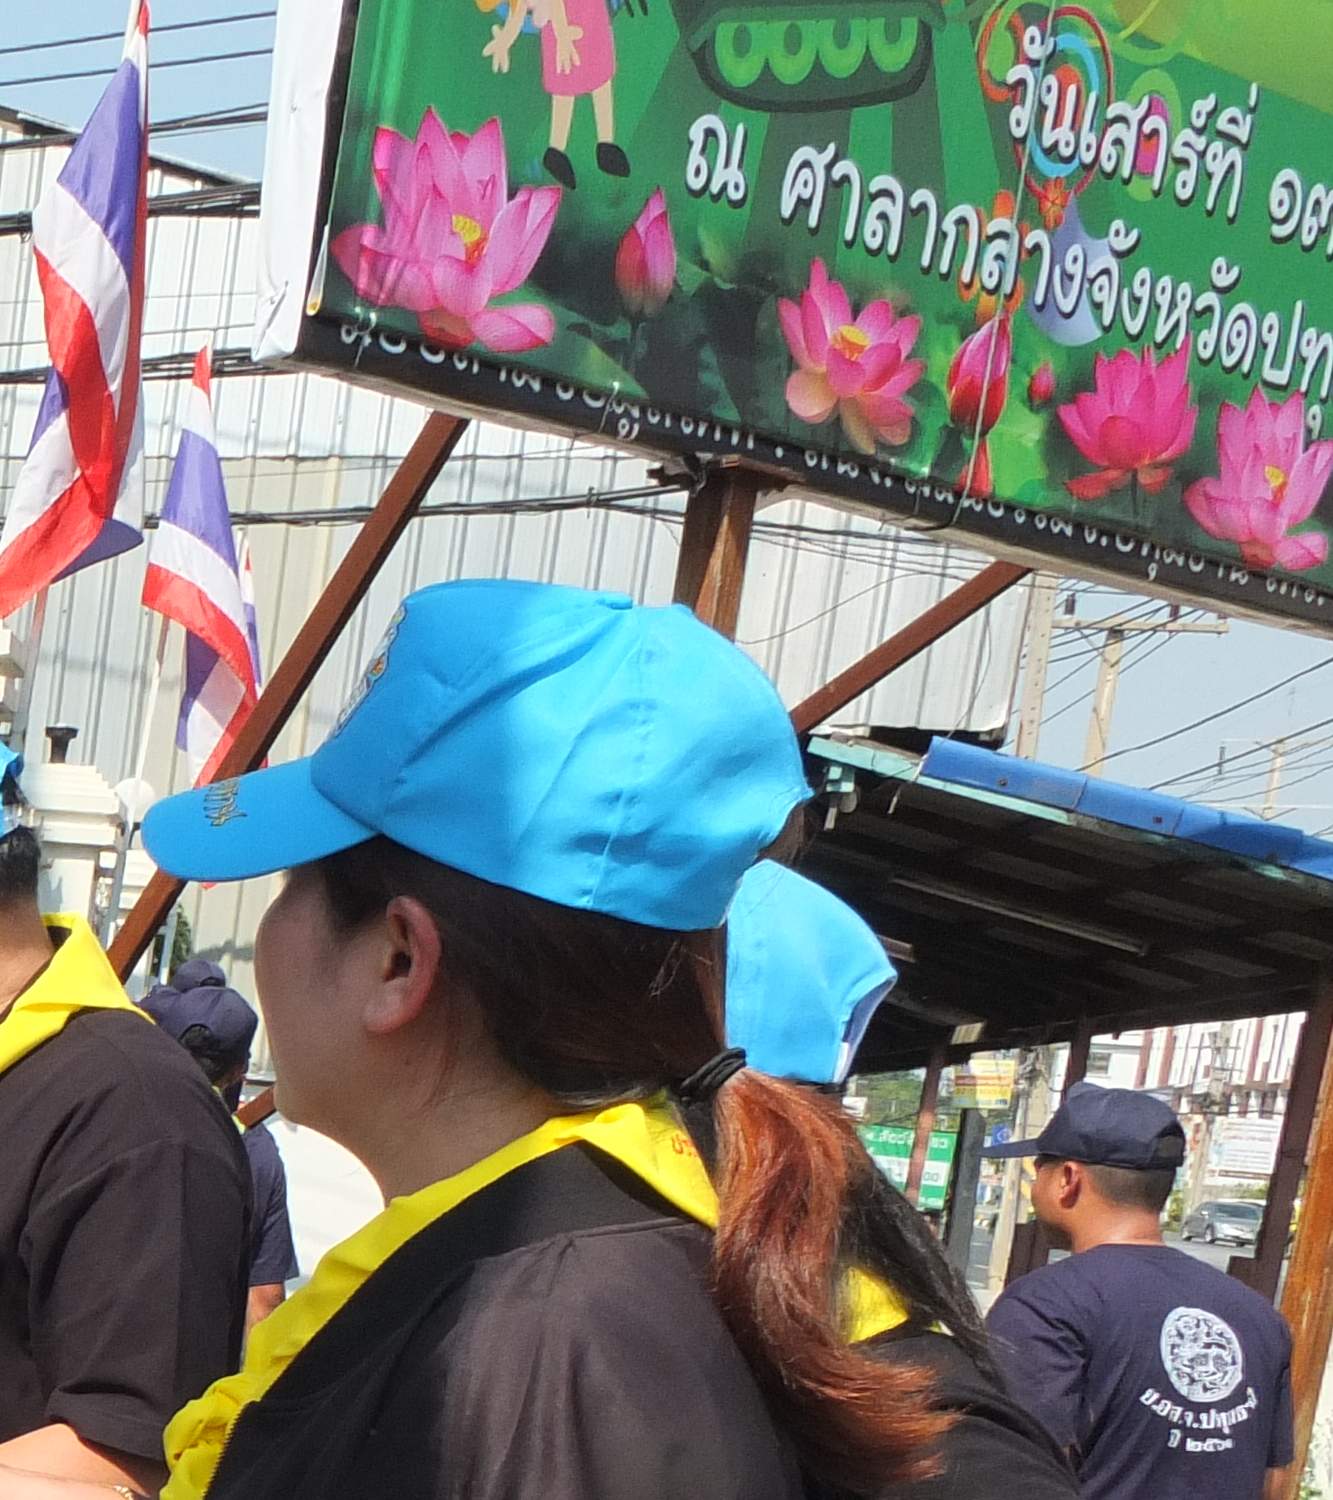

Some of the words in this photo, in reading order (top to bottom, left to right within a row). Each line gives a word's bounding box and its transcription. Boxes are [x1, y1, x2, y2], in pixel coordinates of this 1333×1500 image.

[685, 113, 747, 203] ณ
[1005, 26, 1259, 220] วันเสาร์ที่
